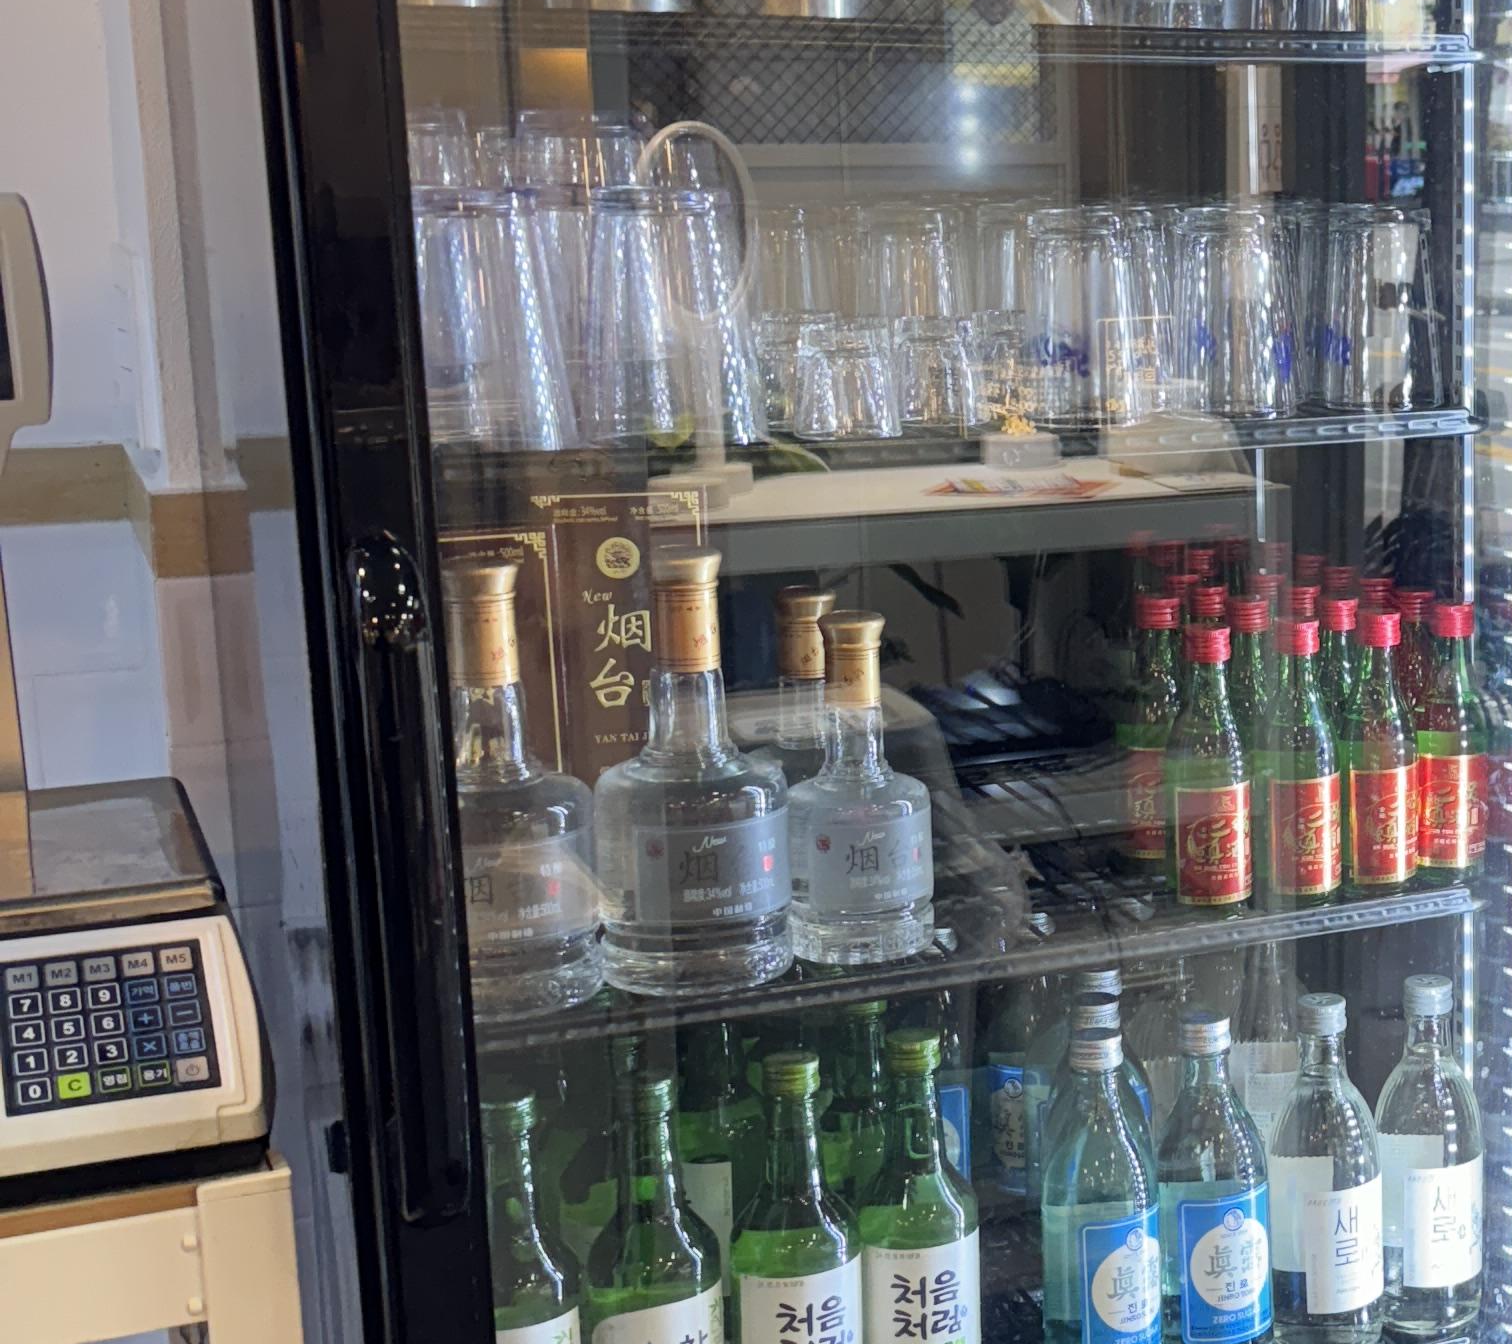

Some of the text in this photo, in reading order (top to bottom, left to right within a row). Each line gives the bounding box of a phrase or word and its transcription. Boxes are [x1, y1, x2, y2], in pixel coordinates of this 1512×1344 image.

[13, 953, 187, 984] M1 M2 M3 M4 M5
[20, 989, 111, 1012] 7 8 9
[22, 1016, 115, 1040] 4 5 6
[26, 1044, 118, 1069] 1 2 3
[28, 1084, 41, 1098] 0
[68, 1078, 82, 1092] C
[890, 1269, 960, 1309] 처음
[776, 1295, 846, 1337] 처음
[892, 1304, 963, 1341] 처럼
